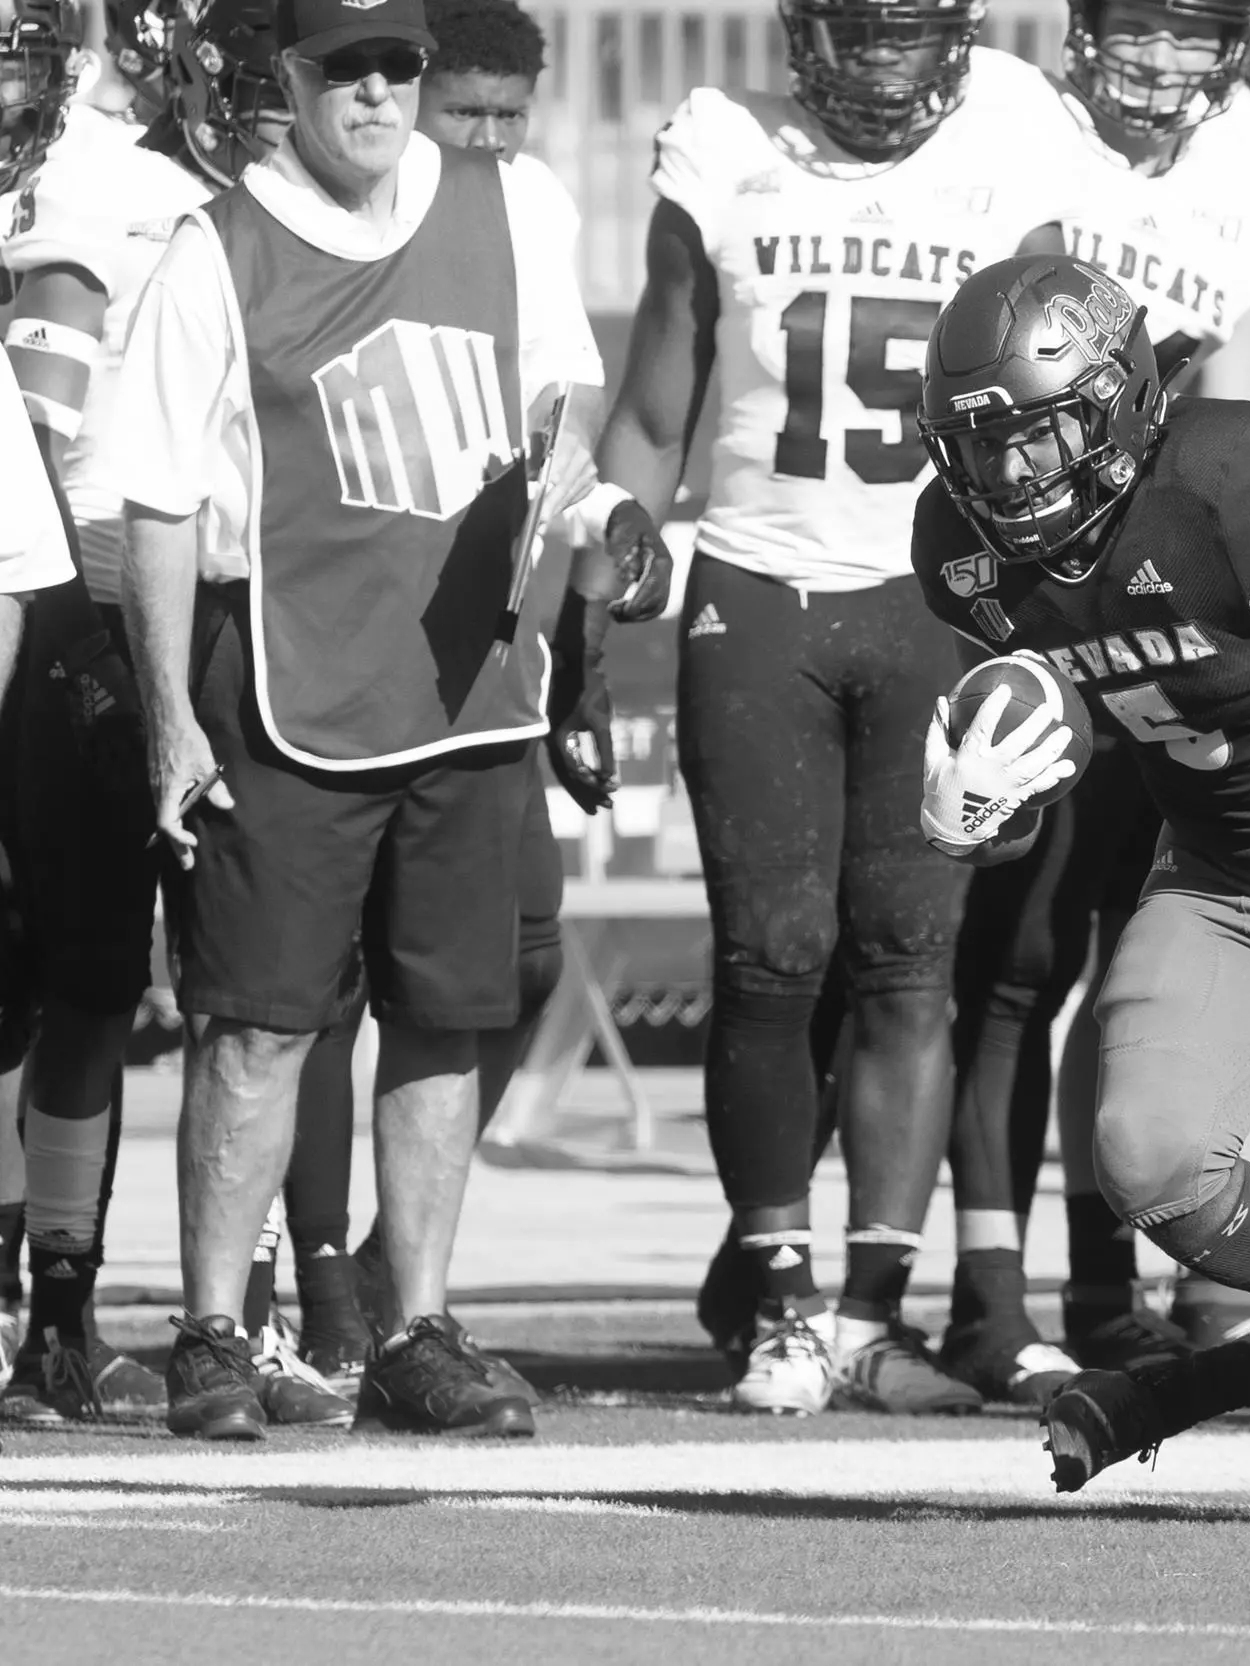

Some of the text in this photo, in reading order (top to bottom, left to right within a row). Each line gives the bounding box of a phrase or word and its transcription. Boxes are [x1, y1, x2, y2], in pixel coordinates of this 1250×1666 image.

[753, 235, 976, 286] WILDCATS
[1069, 226, 1225, 327] ILDCATS
[774, 290, 942, 484] 15
[954, 394, 991, 412] NEVADA
[940, 550, 998, 598] 150
[1127, 580, 1174, 597] adidas
[1045, 620, 1220, 683] EVADA
[1100, 680, 1233, 772] 5
[964, 796, 1008, 834] adidas
